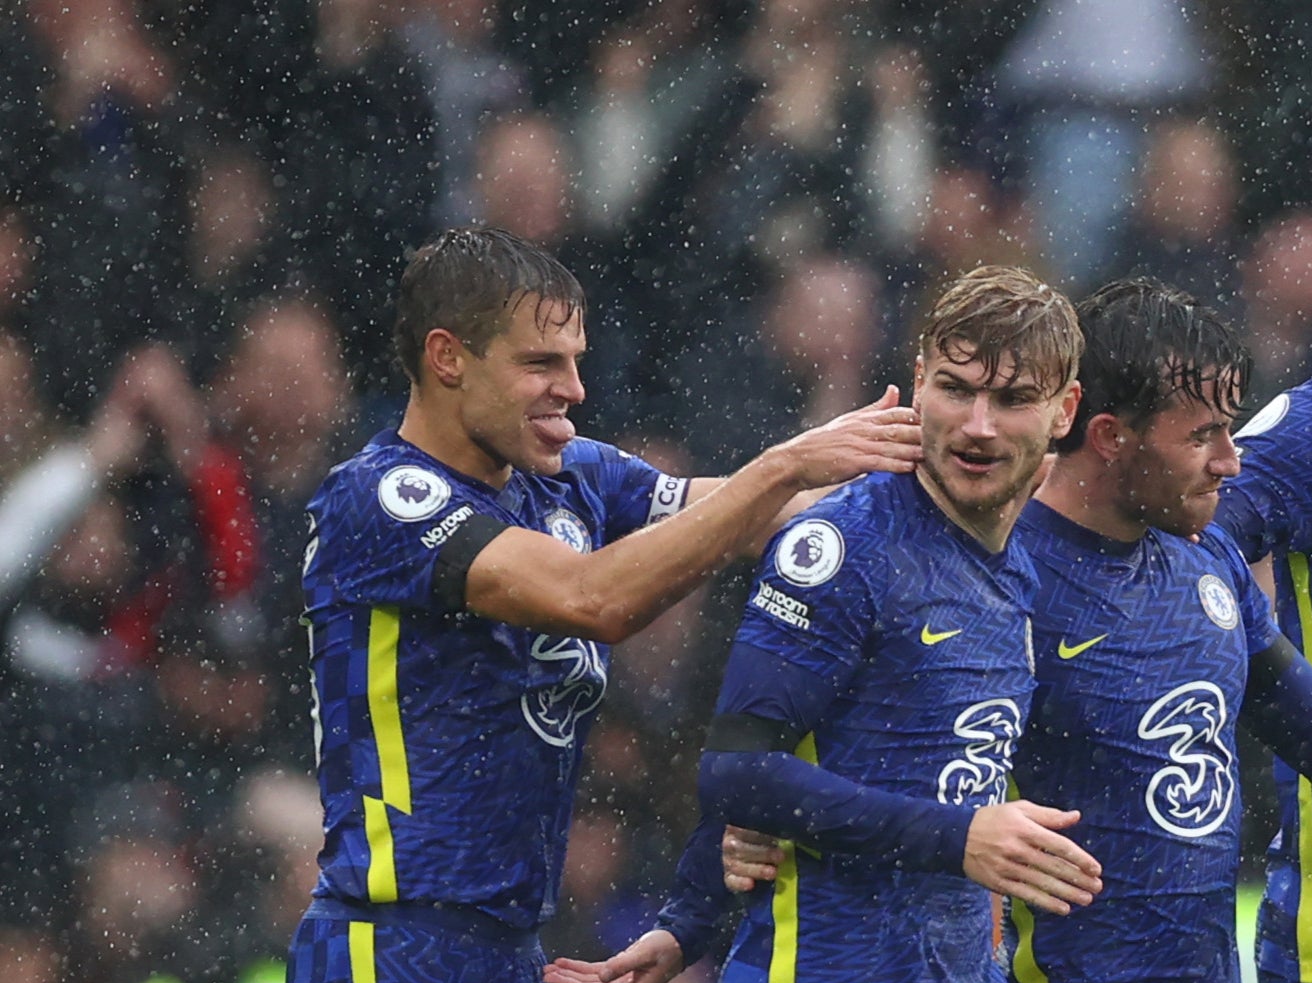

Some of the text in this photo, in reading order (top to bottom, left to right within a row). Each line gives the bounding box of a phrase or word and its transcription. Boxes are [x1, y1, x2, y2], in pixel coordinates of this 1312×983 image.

[420, 527, 443, 549] No
[440, 506, 474, 531] room
[759, 580, 809, 617] No room
[765, 602, 810, 630] racism
